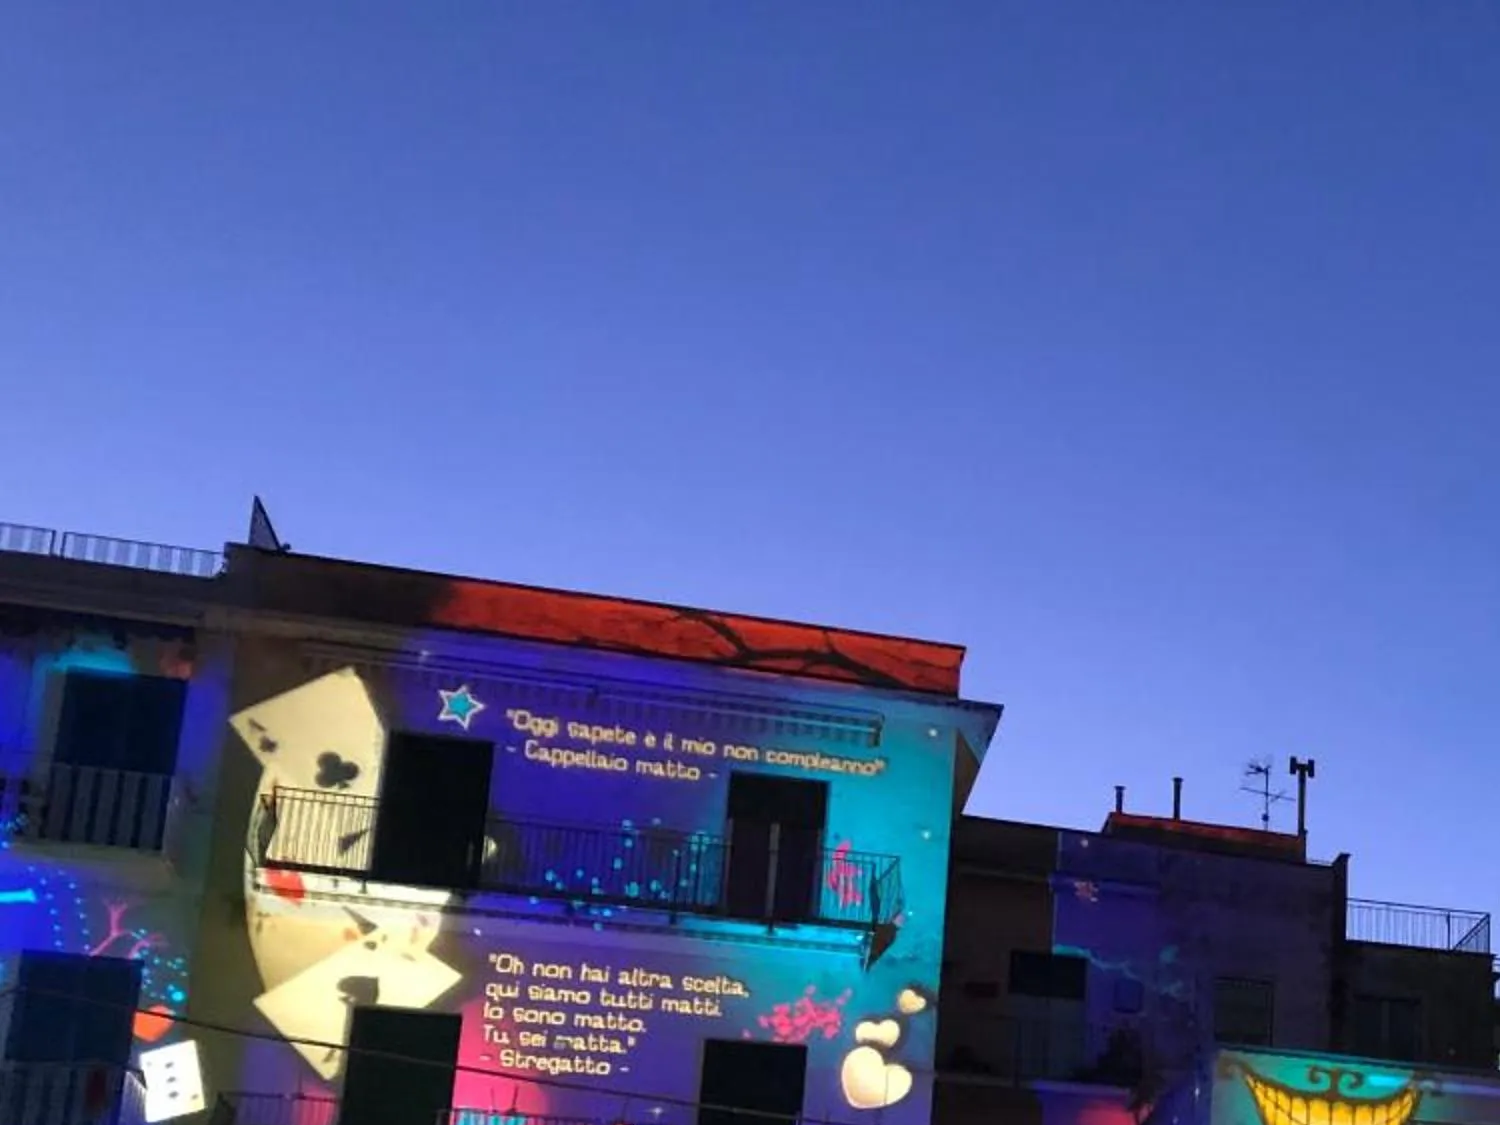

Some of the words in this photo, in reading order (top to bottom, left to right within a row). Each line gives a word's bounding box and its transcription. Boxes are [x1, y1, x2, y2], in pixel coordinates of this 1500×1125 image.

[567, 721, 636, 745] sapete
[663, 733, 673, 752] il
[681, 737, 716, 755] mio
[723, 744, 758, 761] non
[524, 739, 629, 771] Cappellaio
[636, 759, 700, 780] matto
[485, 980, 519, 1002] qui
[527, 983, 591, 1005] siamo
[600, 987, 653, 1010] tutti
[532, 962, 572, 979] non
[580, 962, 610, 983] hai
[618, 967, 673, 989] altra
[682, 976, 749, 998] scelta,
[483, 1001, 504, 1019] Io
[512, 1007, 566, 1025] sono
[573, 1011, 646, 1033] matto.
[483, 1024, 509, 1044] Tu
[519, 1030, 548, 1048] sei
[499, 1048, 611, 1075] Stregatto
